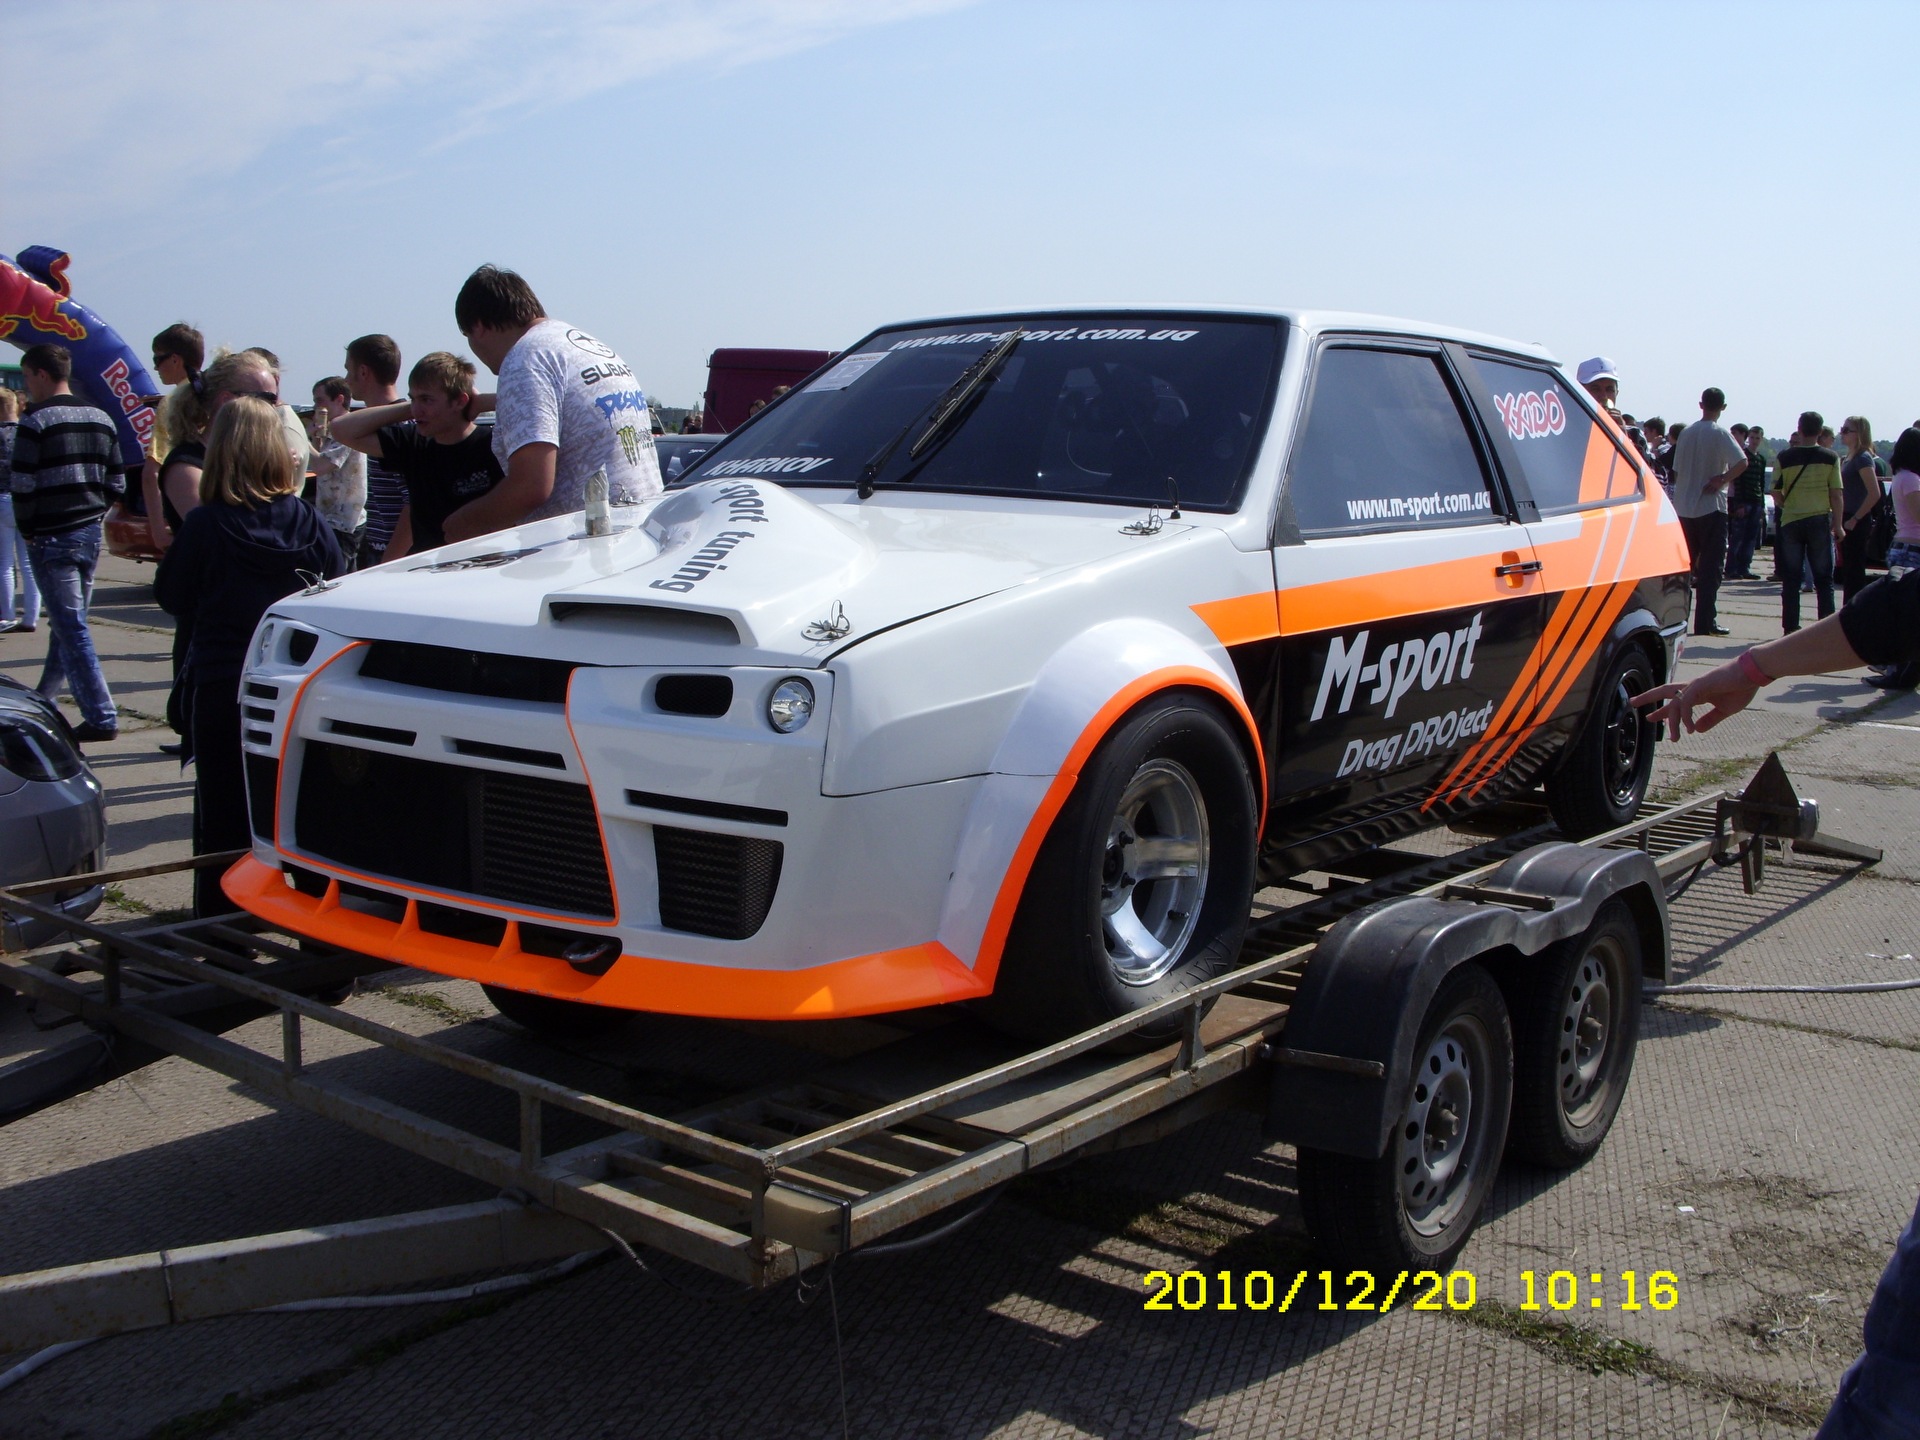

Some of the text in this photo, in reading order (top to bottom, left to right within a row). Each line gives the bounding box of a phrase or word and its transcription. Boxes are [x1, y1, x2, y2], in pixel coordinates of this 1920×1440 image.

[100, 357, 143, 415] Red
[1493, 389, 1567, 441] XADO
[702, 457, 833, 477] KHARKOV
[1346, 490, 1491, 521] www.m-sport.com.ua
[648, 531, 756, 594] tuning
[1309, 611, 1483, 722] M-sport
[1335, 733, 1403, 778] Drag
